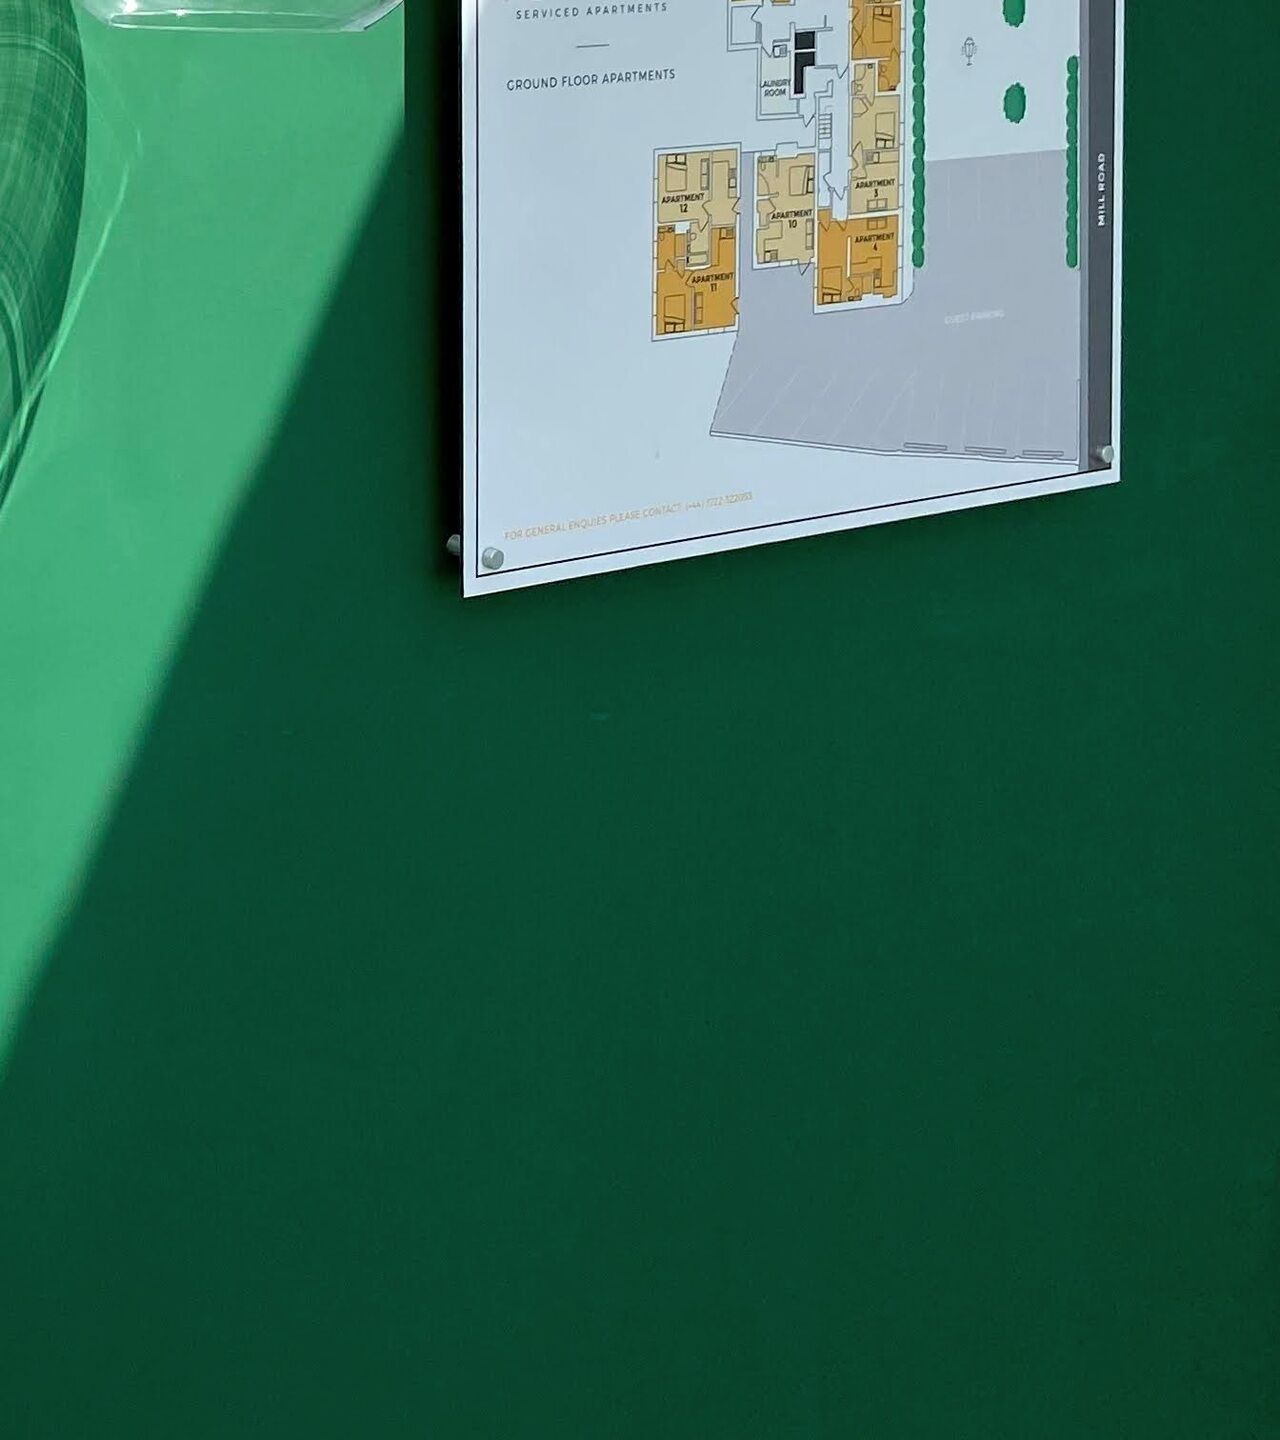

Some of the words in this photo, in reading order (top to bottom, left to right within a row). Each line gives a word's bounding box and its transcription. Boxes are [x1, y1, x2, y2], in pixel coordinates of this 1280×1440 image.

[516, 7, 579, 20] SERVICED
[586, 2, 667, 16] APARTMENTS
[506, 76, 558, 91] GROUND
[561, 74, 598, 88] FLOOR
[602, 68, 675, 85] APARTMENTS
[761, 79, 790, 89] LAUNDRY
[764, 88, 786, 98] ROOM
[1097, 152, 1106, 191] ROAD
[855, 178, 895, 189] APARTMENT
[661, 192, 705, 204] APARTMENT
[679, 203, 688, 213] 12
[1097, 194, 1106, 227] MILL
[771, 209, 813, 220] APARTMENT
[788, 219, 798, 229] 10
[854, 233, 895, 243] APARTMENT
[691, 273, 734, 284] APARTMENT
[710, 282, 718, 292] 11
[504, 531, 523, 541] FOR
[525, 524, 568, 538] GENERAL
[609, 511, 640, 523] PLEASE
